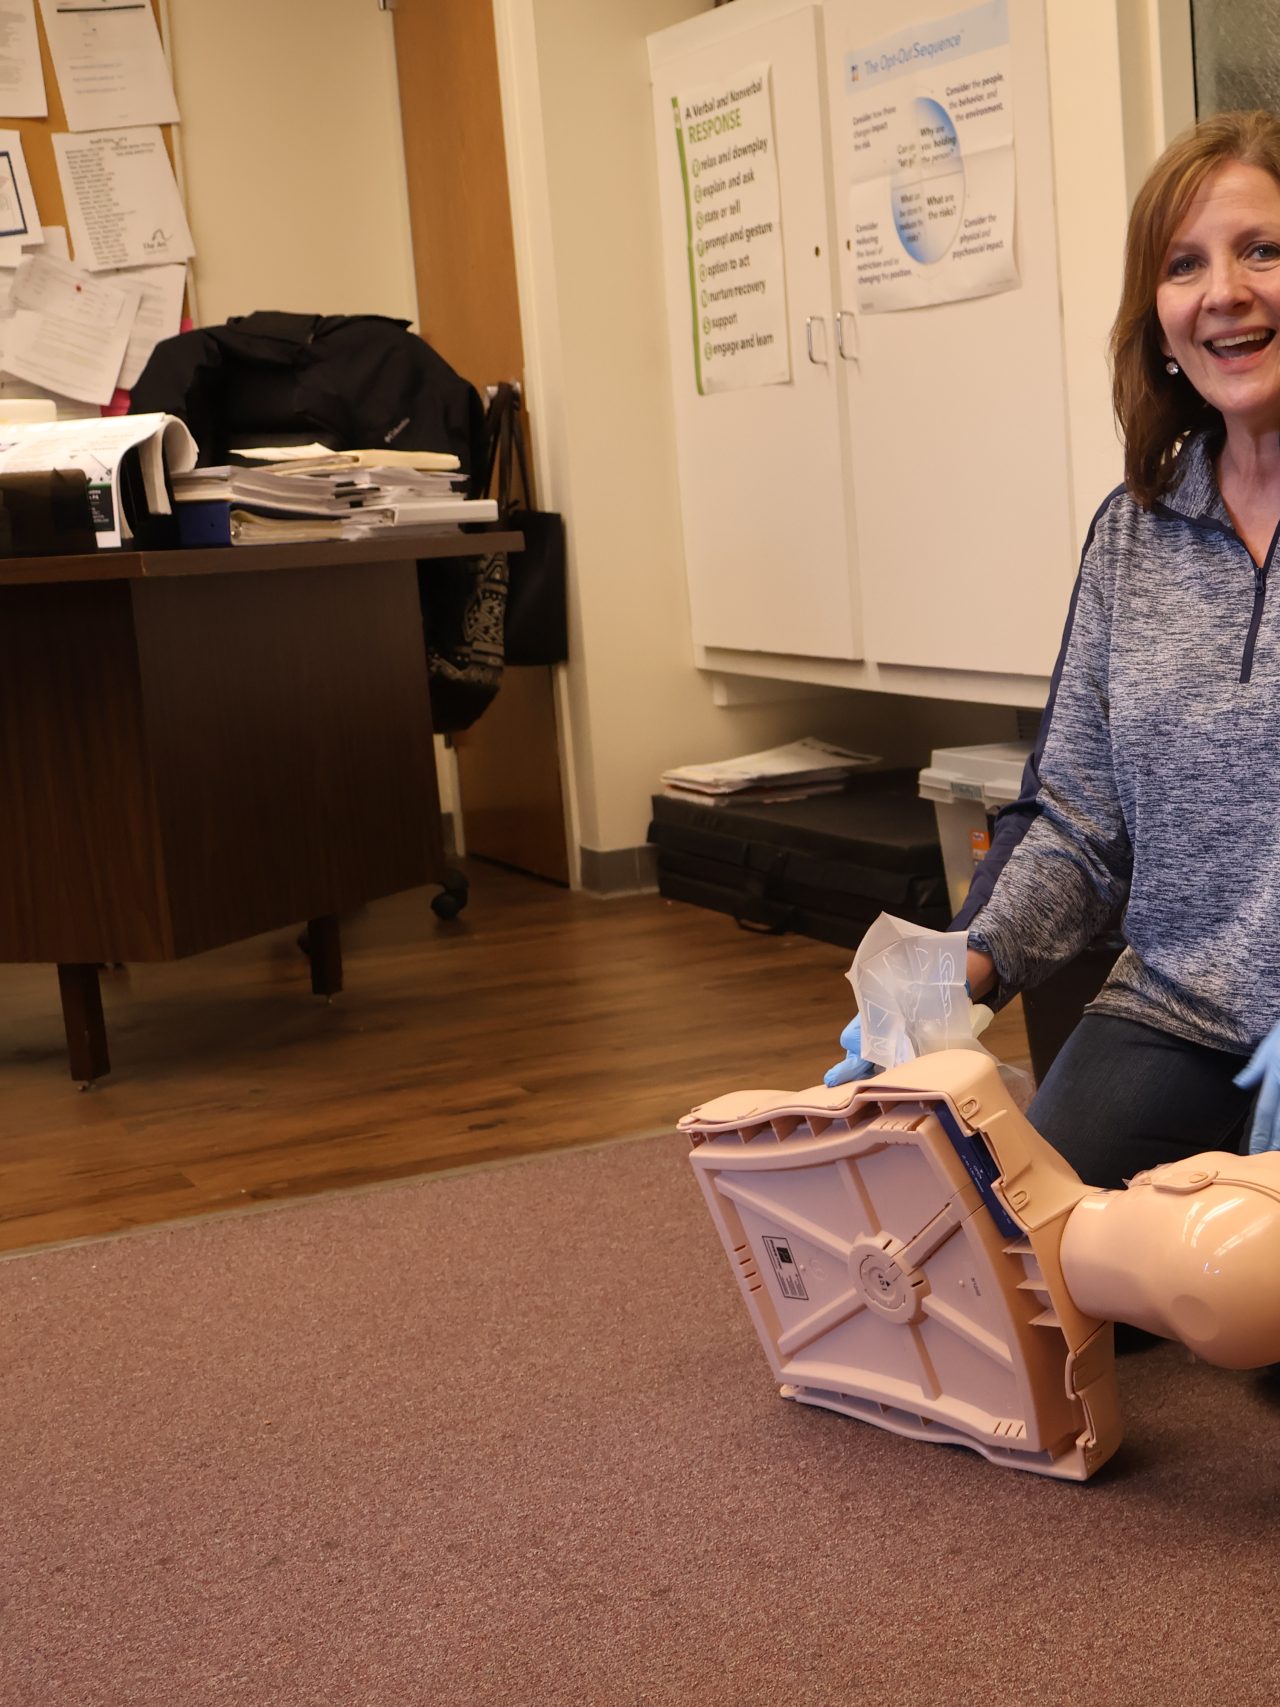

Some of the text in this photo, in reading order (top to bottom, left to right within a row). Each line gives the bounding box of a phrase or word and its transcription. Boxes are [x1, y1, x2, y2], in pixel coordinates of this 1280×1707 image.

[912, 33, 961, 59] Sequence
[685, 106, 692, 120] A
[692, 97, 715, 117] Verbal
[716, 94, 728, 109] and
[730, 78, 762, 101] Nonverbal
[688, 108, 742, 144] RESPONSE
[920, 127, 934, 137] Why
[718, 147, 731, 166] and
[732, 137, 768, 161] downplay
[702, 177, 727, 200] explain
[728, 172, 741, 190] and
[742, 168, 755, 183] ask
[720, 206, 728, 218] or
[729, 200, 741, 216] tell
[926, 196, 944, 206] What
[704, 231, 730, 254] prompt
[730, 226, 744, 243] and
[745, 222, 773, 243] gesture
[708, 260, 729, 280] option
[738, 254, 750, 268] act
[734, 280, 766, 302] recovery
[713, 340, 740, 358] engage
[740, 334, 754, 350] and
[756, 331, 774, 348] learn
